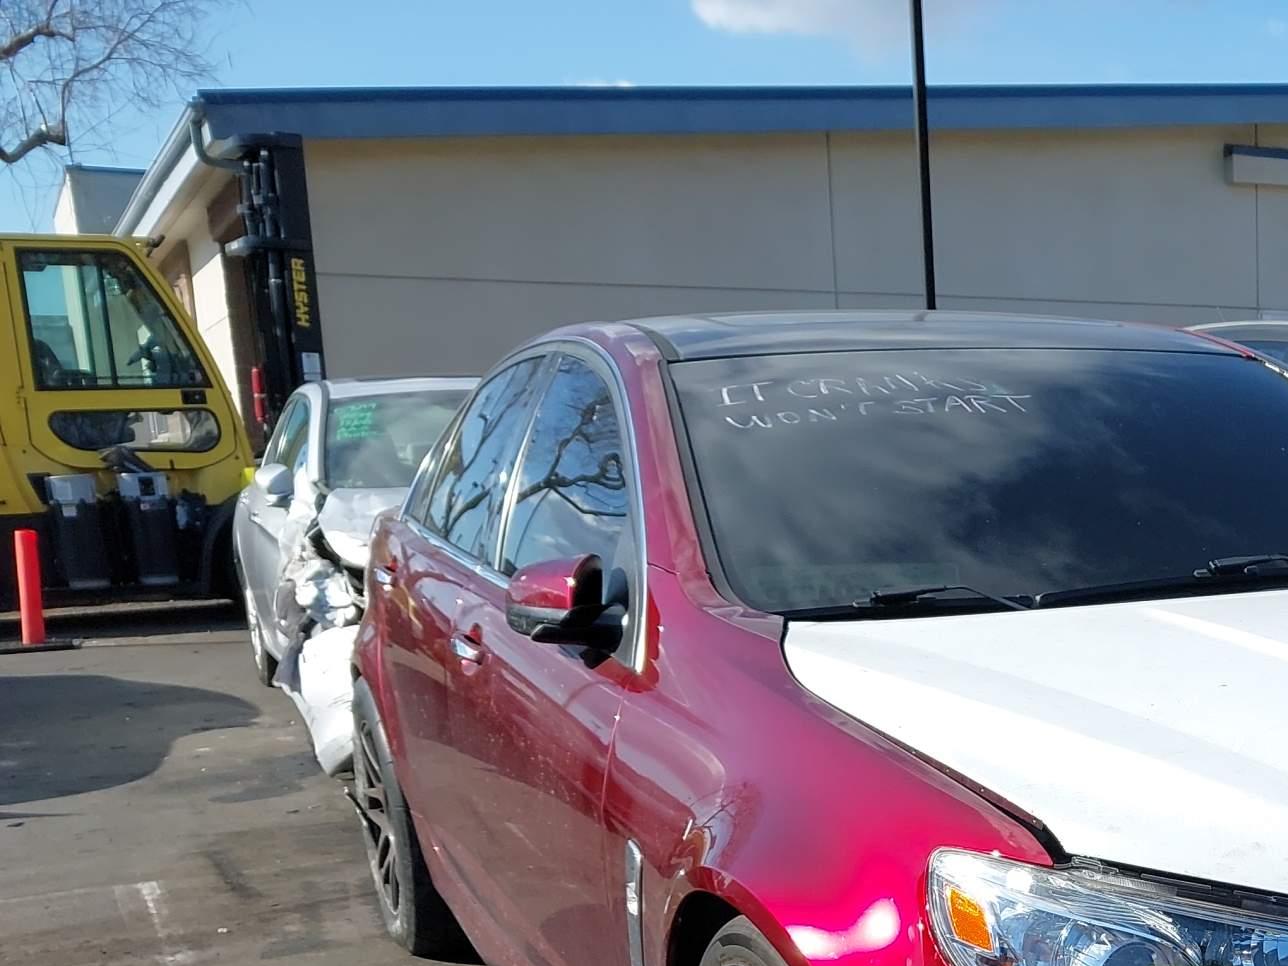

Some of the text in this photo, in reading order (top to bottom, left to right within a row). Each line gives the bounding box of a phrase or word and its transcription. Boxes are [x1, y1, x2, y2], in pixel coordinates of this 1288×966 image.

[291, 257, 311, 328] HYSTER
[717, 381, 775, 407] IT
[725, 394, 1033, 429] WON'T START
